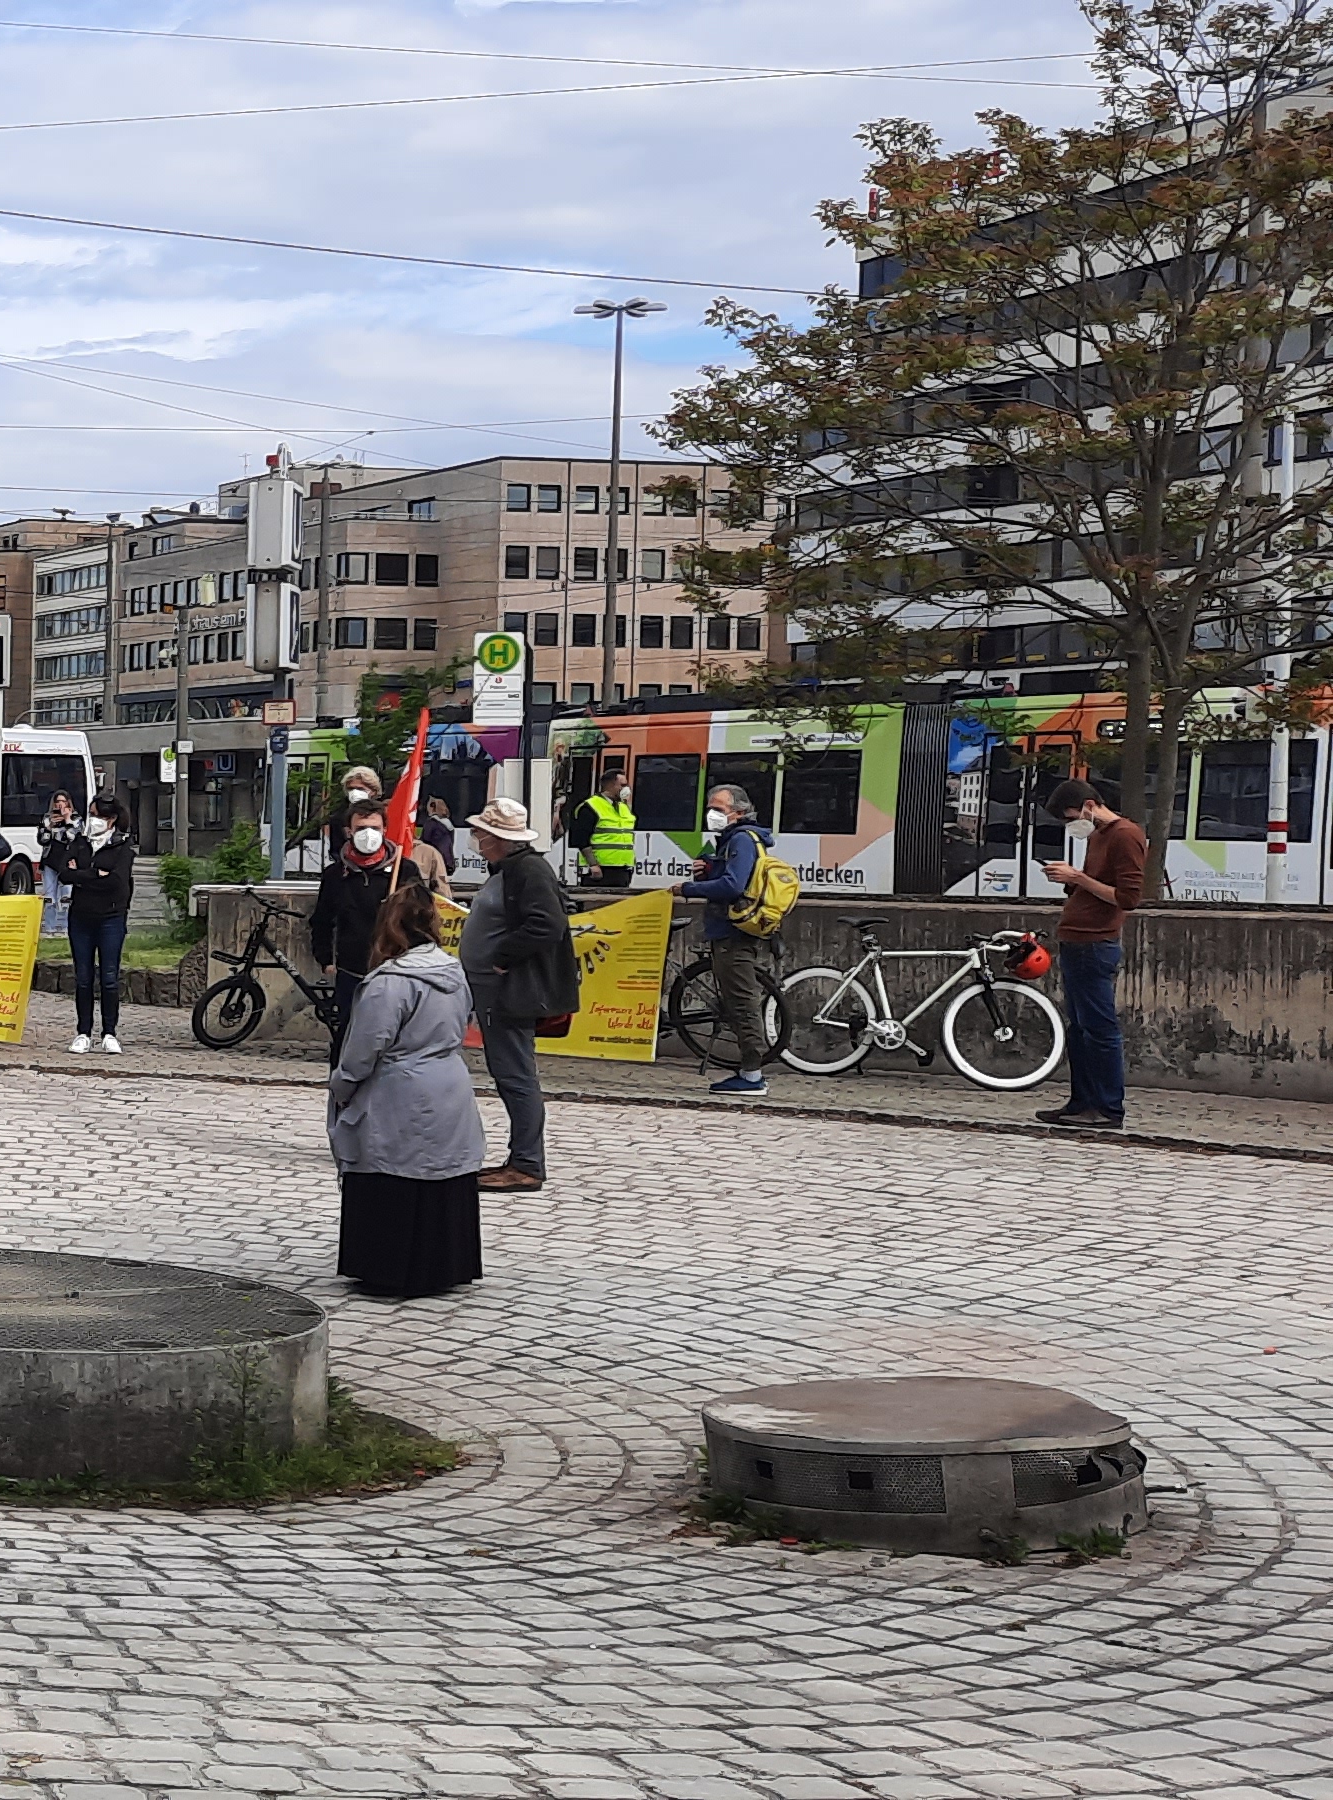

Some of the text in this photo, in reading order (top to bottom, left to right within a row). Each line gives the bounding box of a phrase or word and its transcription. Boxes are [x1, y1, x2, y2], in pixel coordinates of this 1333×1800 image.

[489, 644, 510, 664] H
[219, 754, 232, 771] U
[635, 856, 865, 884] etzt das tdecken
[1184, 888, 1240, 902] PLAUEN
